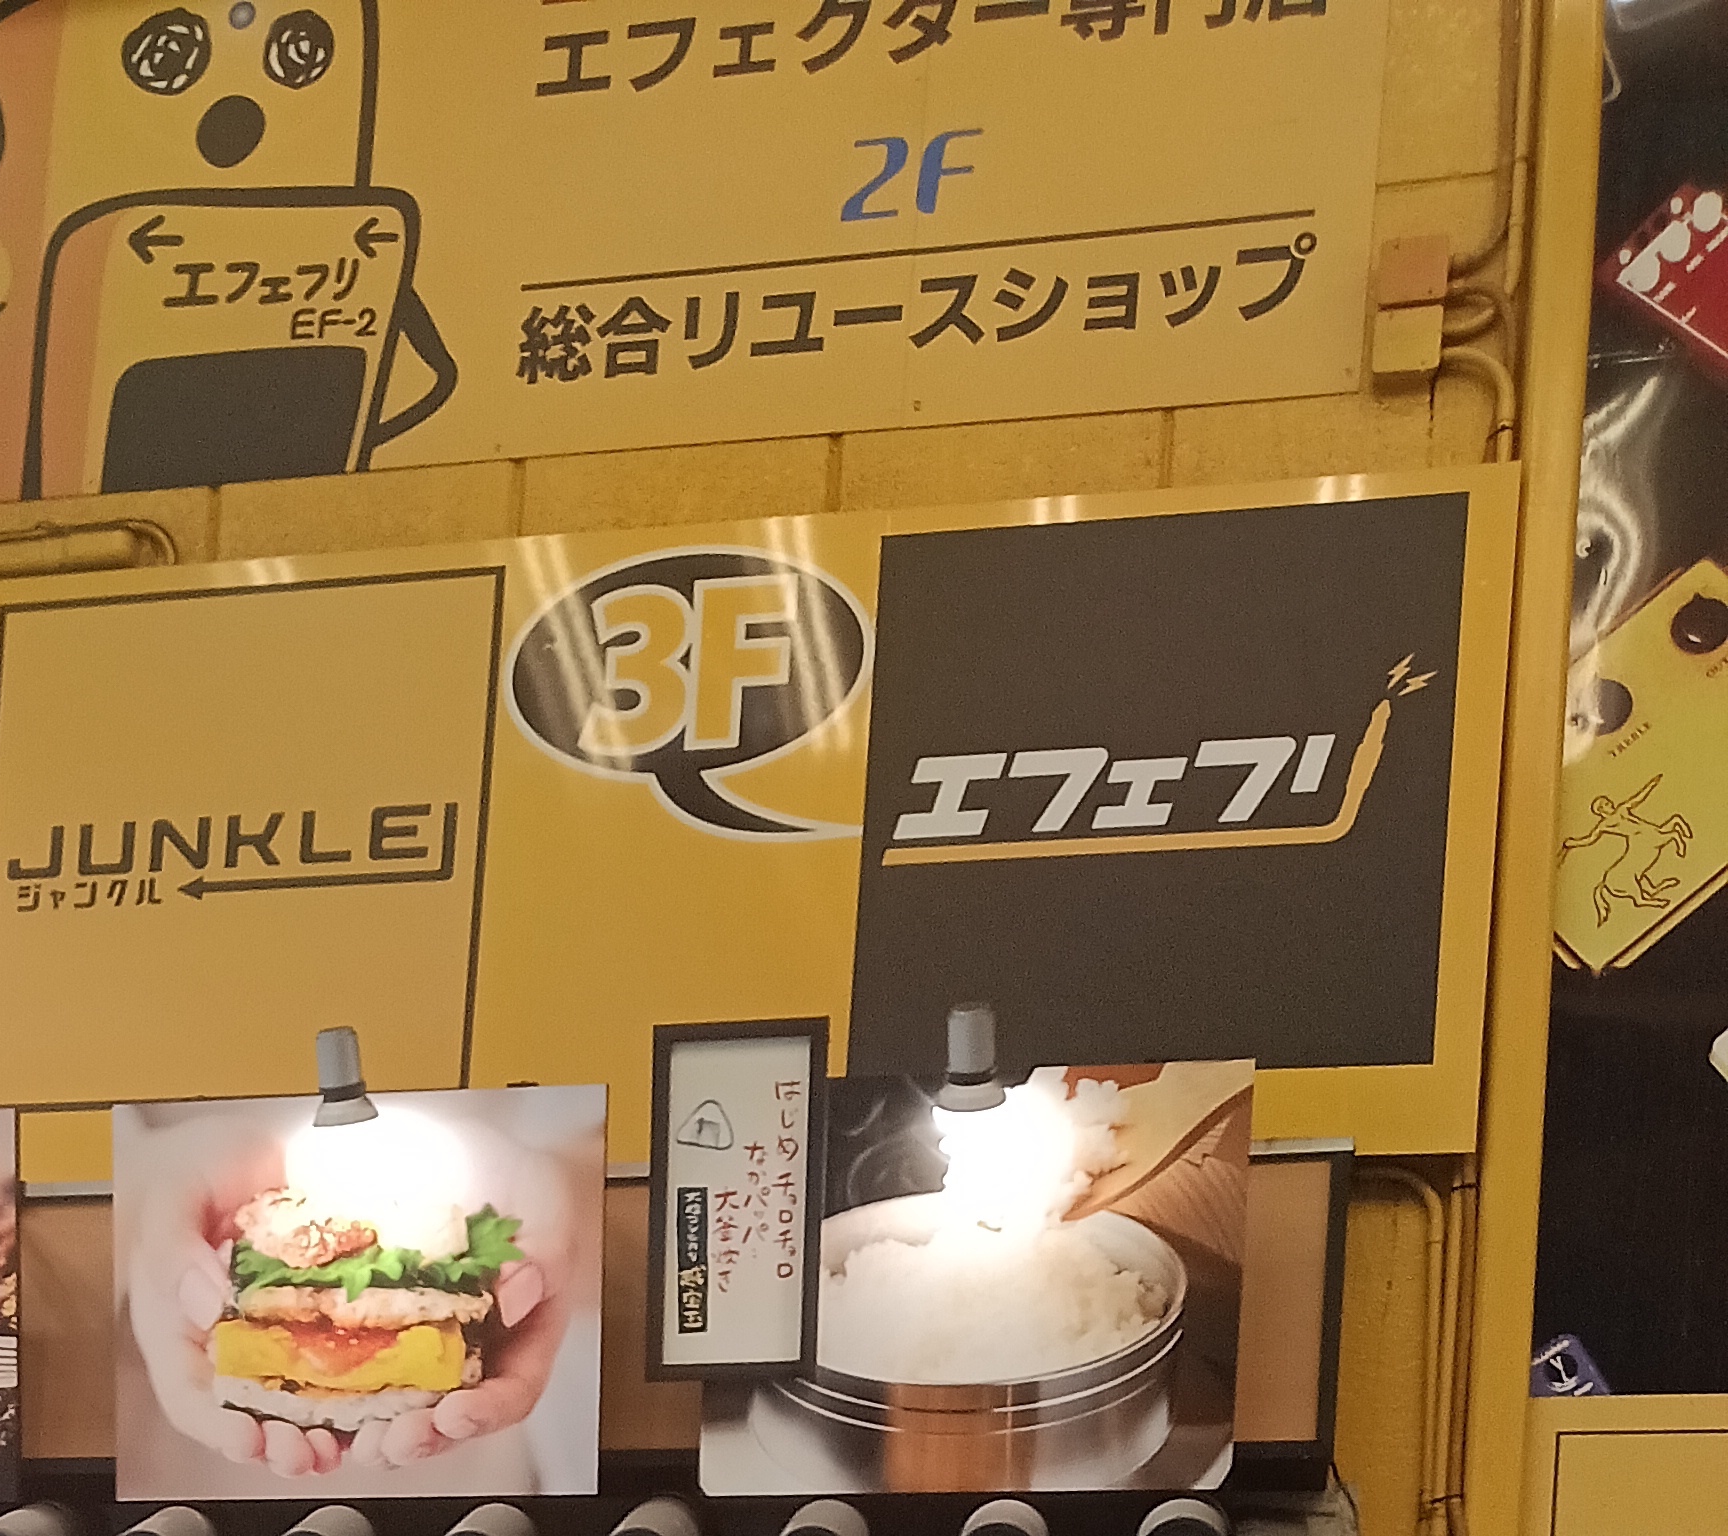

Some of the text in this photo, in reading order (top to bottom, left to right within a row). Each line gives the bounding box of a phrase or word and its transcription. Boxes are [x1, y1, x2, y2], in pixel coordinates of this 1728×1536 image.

[840, 128, 984, 222] 2F
[162, 257, 359, 308] エフェフリ
[516, 231, 1318, 385] 総合リユースショップ
[290, 307, 378, 340] EF-2
[577, 573, 798, 757] 3F
[7, 802, 434, 881] JUNKLE
[16, 877, 165, 913] ジャンクル
